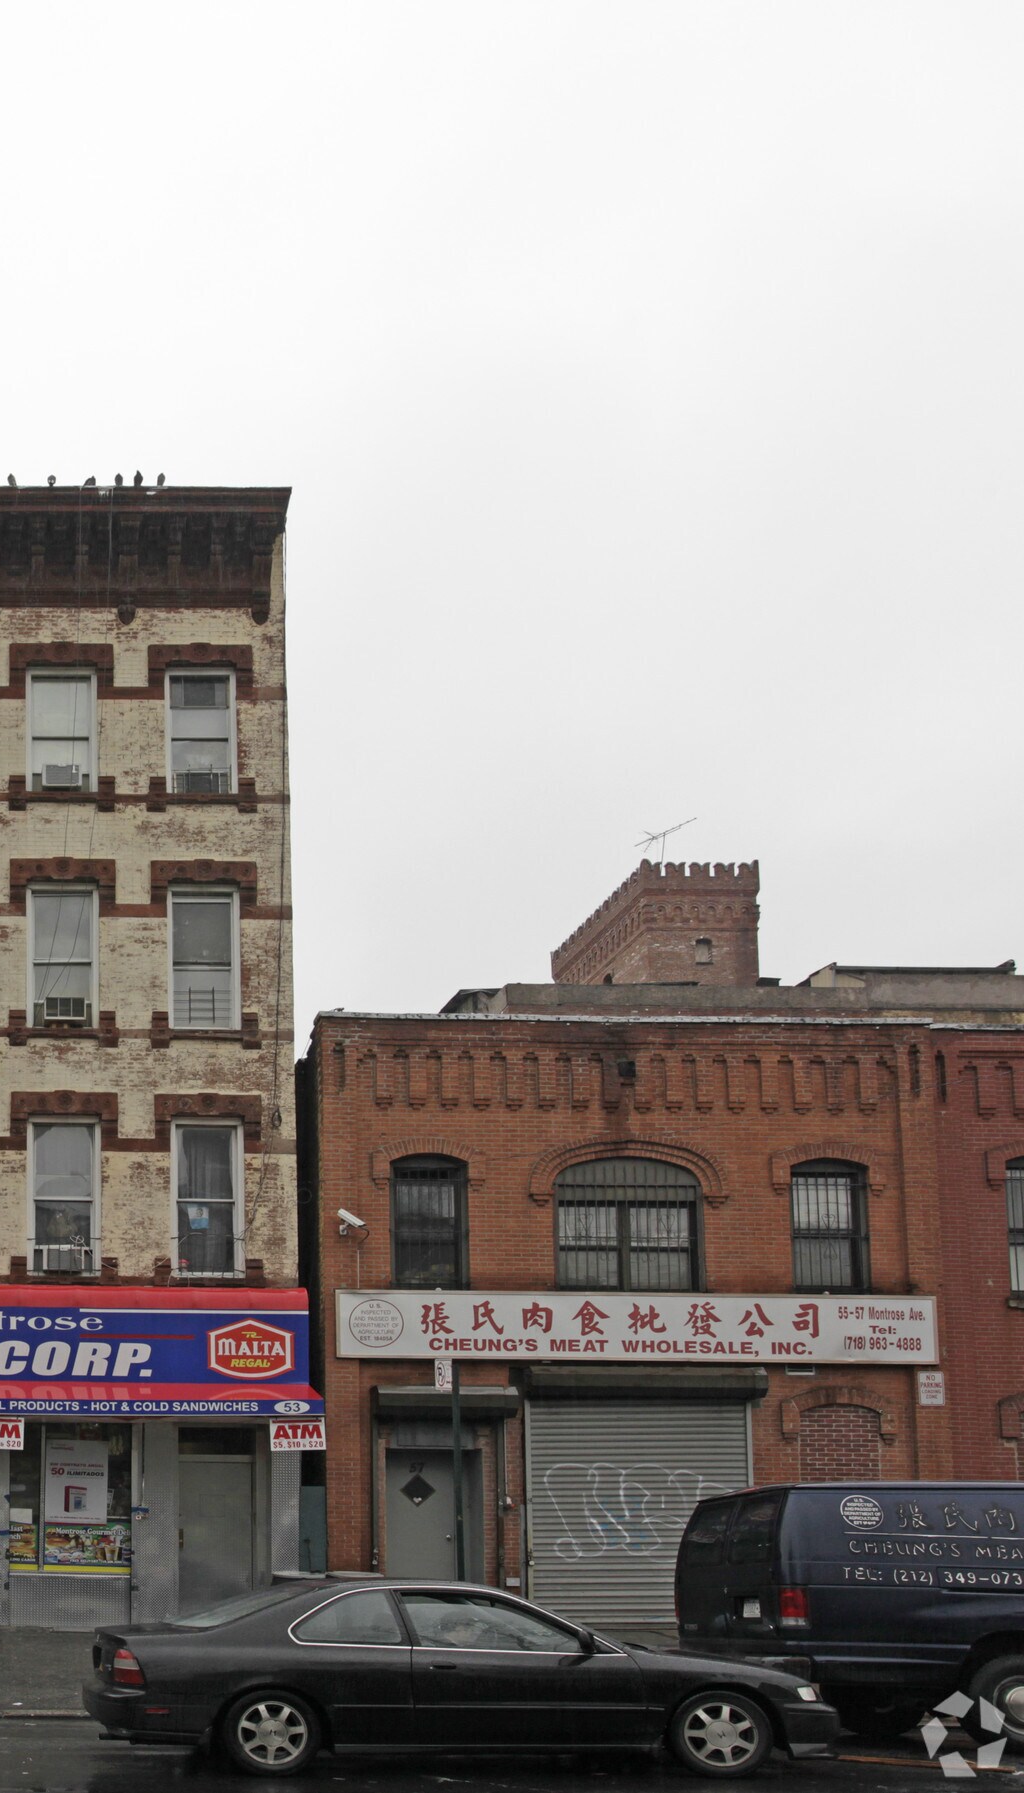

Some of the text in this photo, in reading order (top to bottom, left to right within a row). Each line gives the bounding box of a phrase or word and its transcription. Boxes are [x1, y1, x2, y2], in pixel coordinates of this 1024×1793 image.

[420, 1300, 820, 1339] 張氏肉食批發公司
[838, 1306, 926, 1320] 55-57 Montrose Ave.
[869, 1325, 897, 1335] Tel:
[217, 1338, 285, 1356] MALTA
[429, 1337, 813, 1356] CHEUNG'S MEAT WHOLESALE, INC.
[844, 1335, 866, 1350] (718)
[230, 1359, 270, 1368] REGAL
[9, 1400, 79, 1411] PRODUCTS
[91, 1401, 118, 1411] HOT
[121, 1401, 130, 1411] &
[133, 1401, 169, 1411] COLD
[172, 1401, 258, 1412] SANDWICHES
[284, 1402, 300, 1412] 53
[273, 1424, 322, 1439] ATM
[6, 1439, 21, 1448] $20
[287, 1441, 301, 1449] $10
[308, 1440, 323, 1448] $20
[51, 1467, 65, 1475] 50
[56, 1527, 86, 1535] Montrose
[87, 1528, 117, 1536] Gourmet
[849, 1540, 961, 1557] CHEUNG'S
[842, 1567, 1023, 1585] TEL: (212) 349-073
